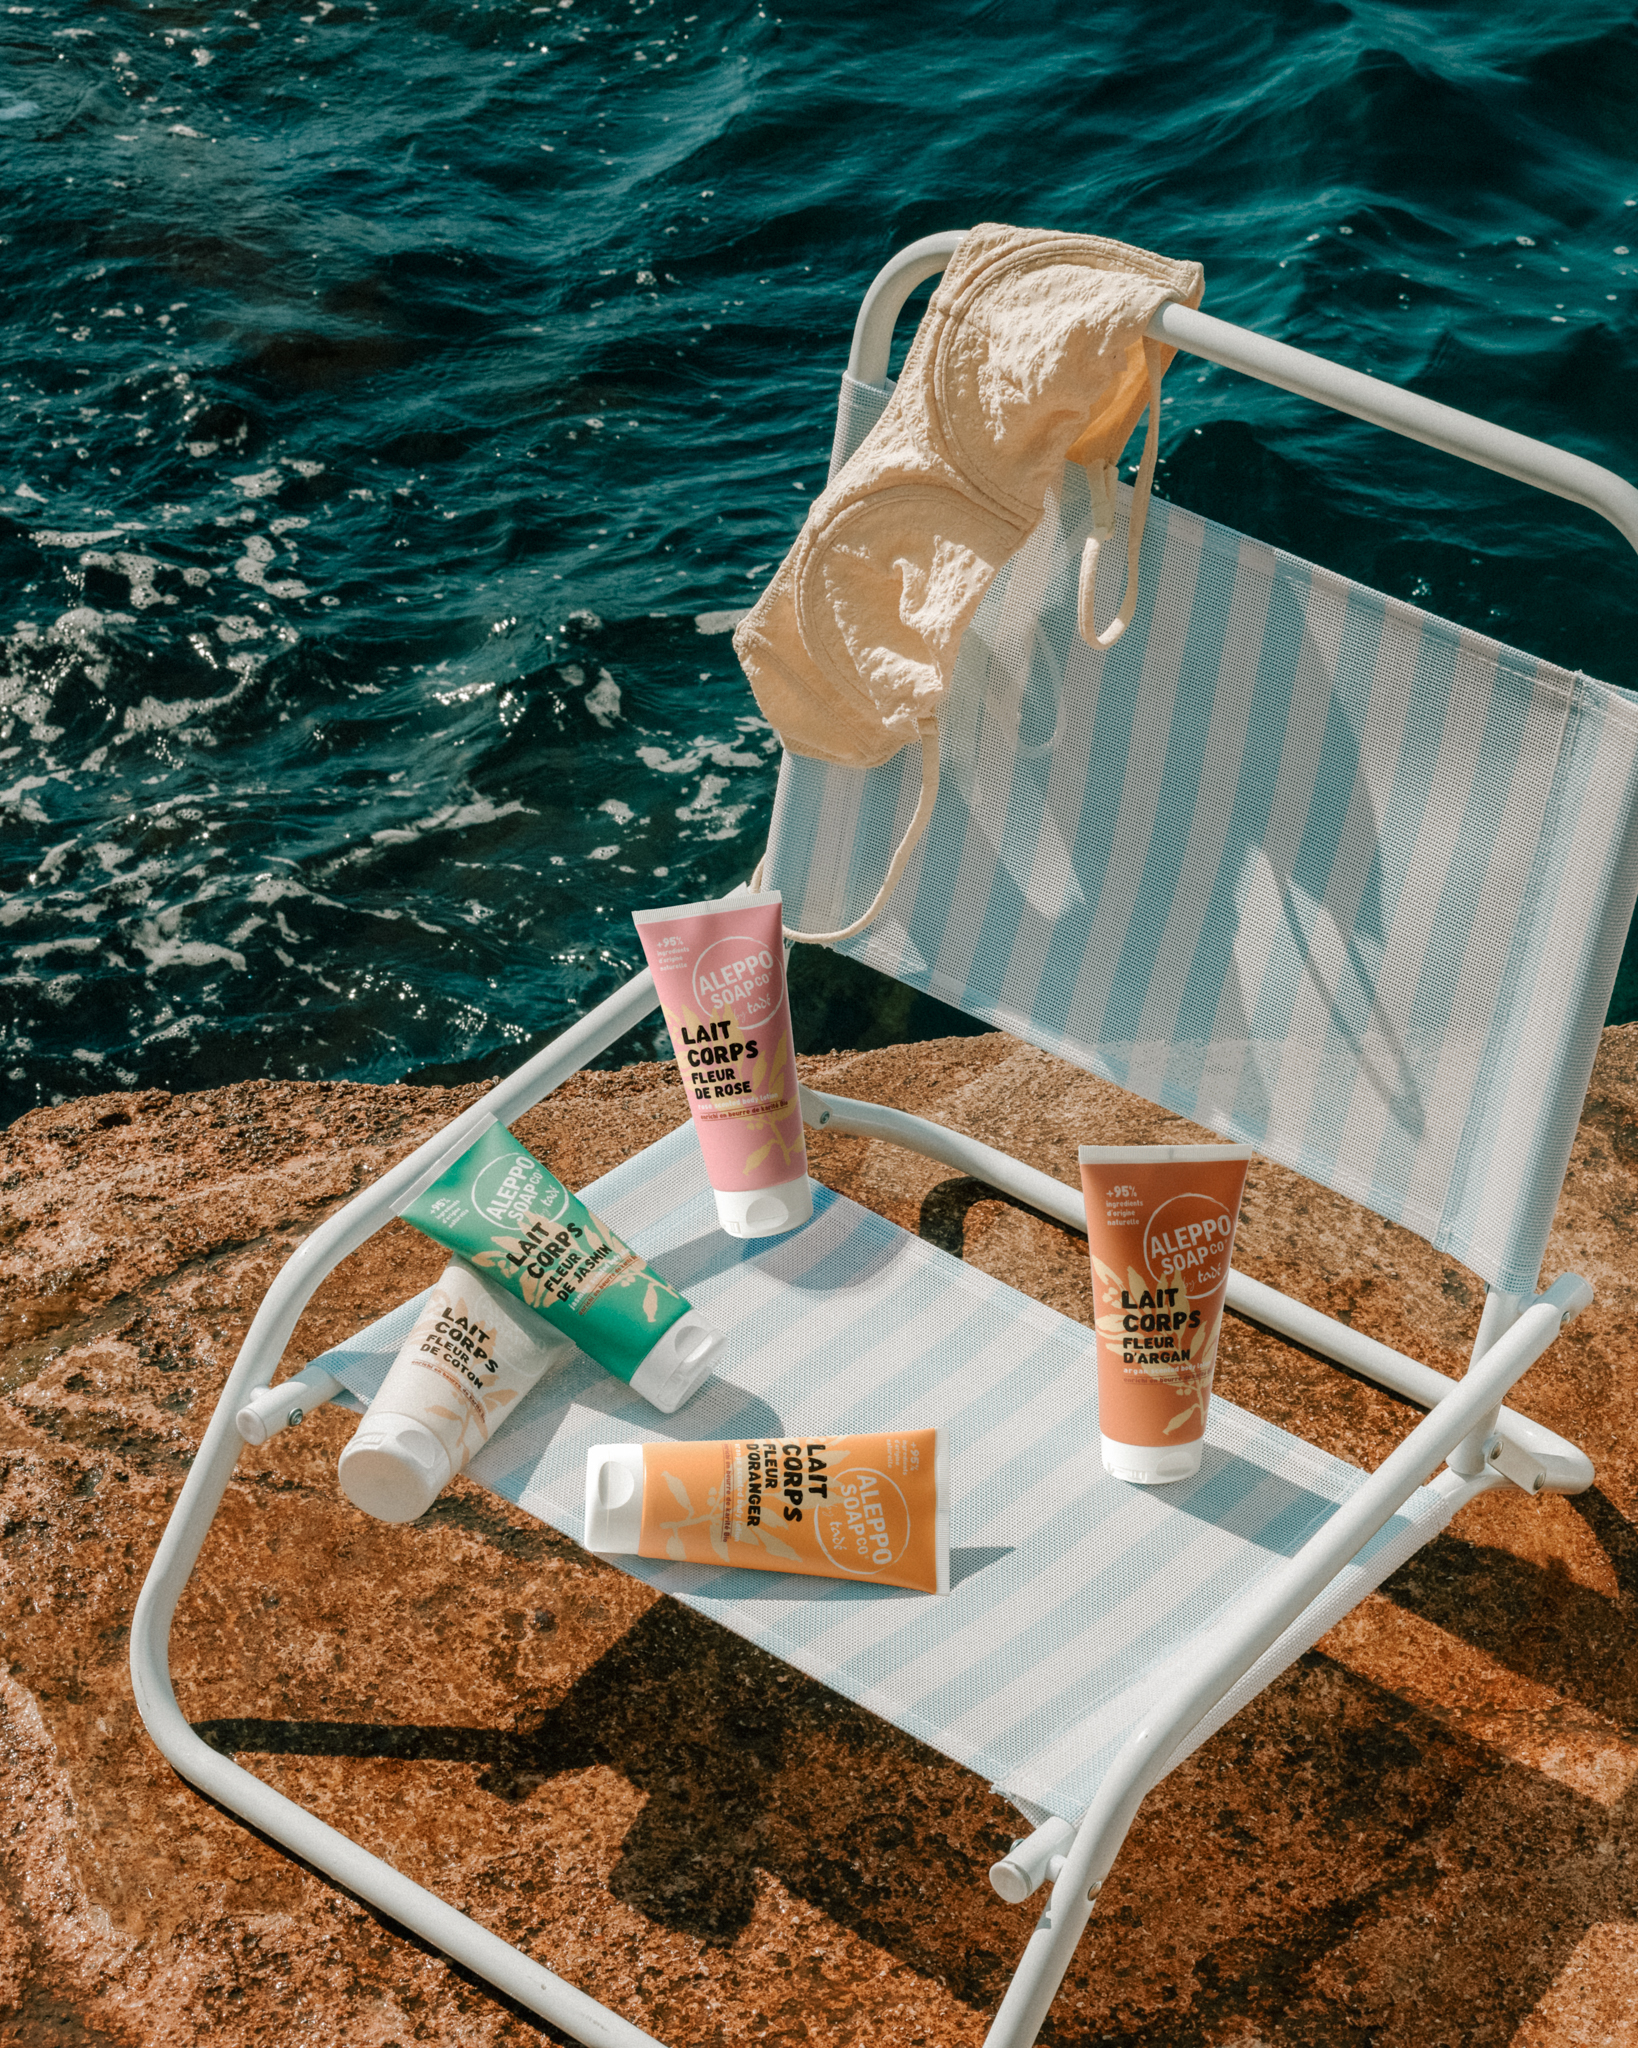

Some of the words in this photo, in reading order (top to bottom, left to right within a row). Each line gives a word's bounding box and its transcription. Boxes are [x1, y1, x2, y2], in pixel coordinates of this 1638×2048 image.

[656, 936, 684, 948] +95%
[699, 950, 774, 996] ALEPPO
[710, 979, 755, 1009] SOAP
[681, 1020, 731, 1045] LAIT
[687, 1040, 759, 1068] CORPS
[691, 1067, 736, 1085] FLEUR
[694, 1085, 712, 1100] DE
[715, 1080, 752, 1099] ROSE
[714, 1098, 741, 1109] scented
[742, 1095, 759, 1107] body
[727, 1108, 751, 1118] beurre
[486, 1156, 536, 1221] ALEPPO
[508, 1183, 539, 1221] SOAP
[1105, 1185, 1138, 1198] +95%
[1105, 1199, 1144, 1209] ingredients
[1106, 1208, 1135, 1218] d'origine
[1107, 1218, 1140, 1226] naturelle
[505, 1221, 550, 1268] LAIT
[526, 1222, 583, 1279] CORPS
[1150, 1214, 1231, 1259] ALEPPO
[543, 1251, 582, 1293] FLEUR
[556, 1281, 576, 1303] DE
[573, 1243, 613, 1284] JASMIN
[1160, 1246, 1209, 1275] SOAP
[1121, 1288, 1179, 1310] LAIT
[441, 1306, 490, 1344] LAIT
[1122, 1310, 1202, 1333] CORPS
[426, 1334, 470, 1365] FLEUR
[434, 1321, 499, 1374] CORPS
[1122, 1336, 1175, 1350] FLEUR
[1123, 1349, 1191, 1364] D'ARGAN
[419, 1343, 440, 1357] DE
[443, 1353, 484, 1390] COTON
[1123, 1367, 1149, 1376] argan
[762, 1443, 778, 1489] FLEUR
[806, 1443, 828, 1499] LAIT
[909, 1441, 920, 1472] +95%
[746, 1443, 762, 1527] D'ORANGER
[782, 1443, 803, 1523] CORPS
[840, 1483, 865, 1535] SOAP
[856, 1474, 893, 1565] ALEPPO
